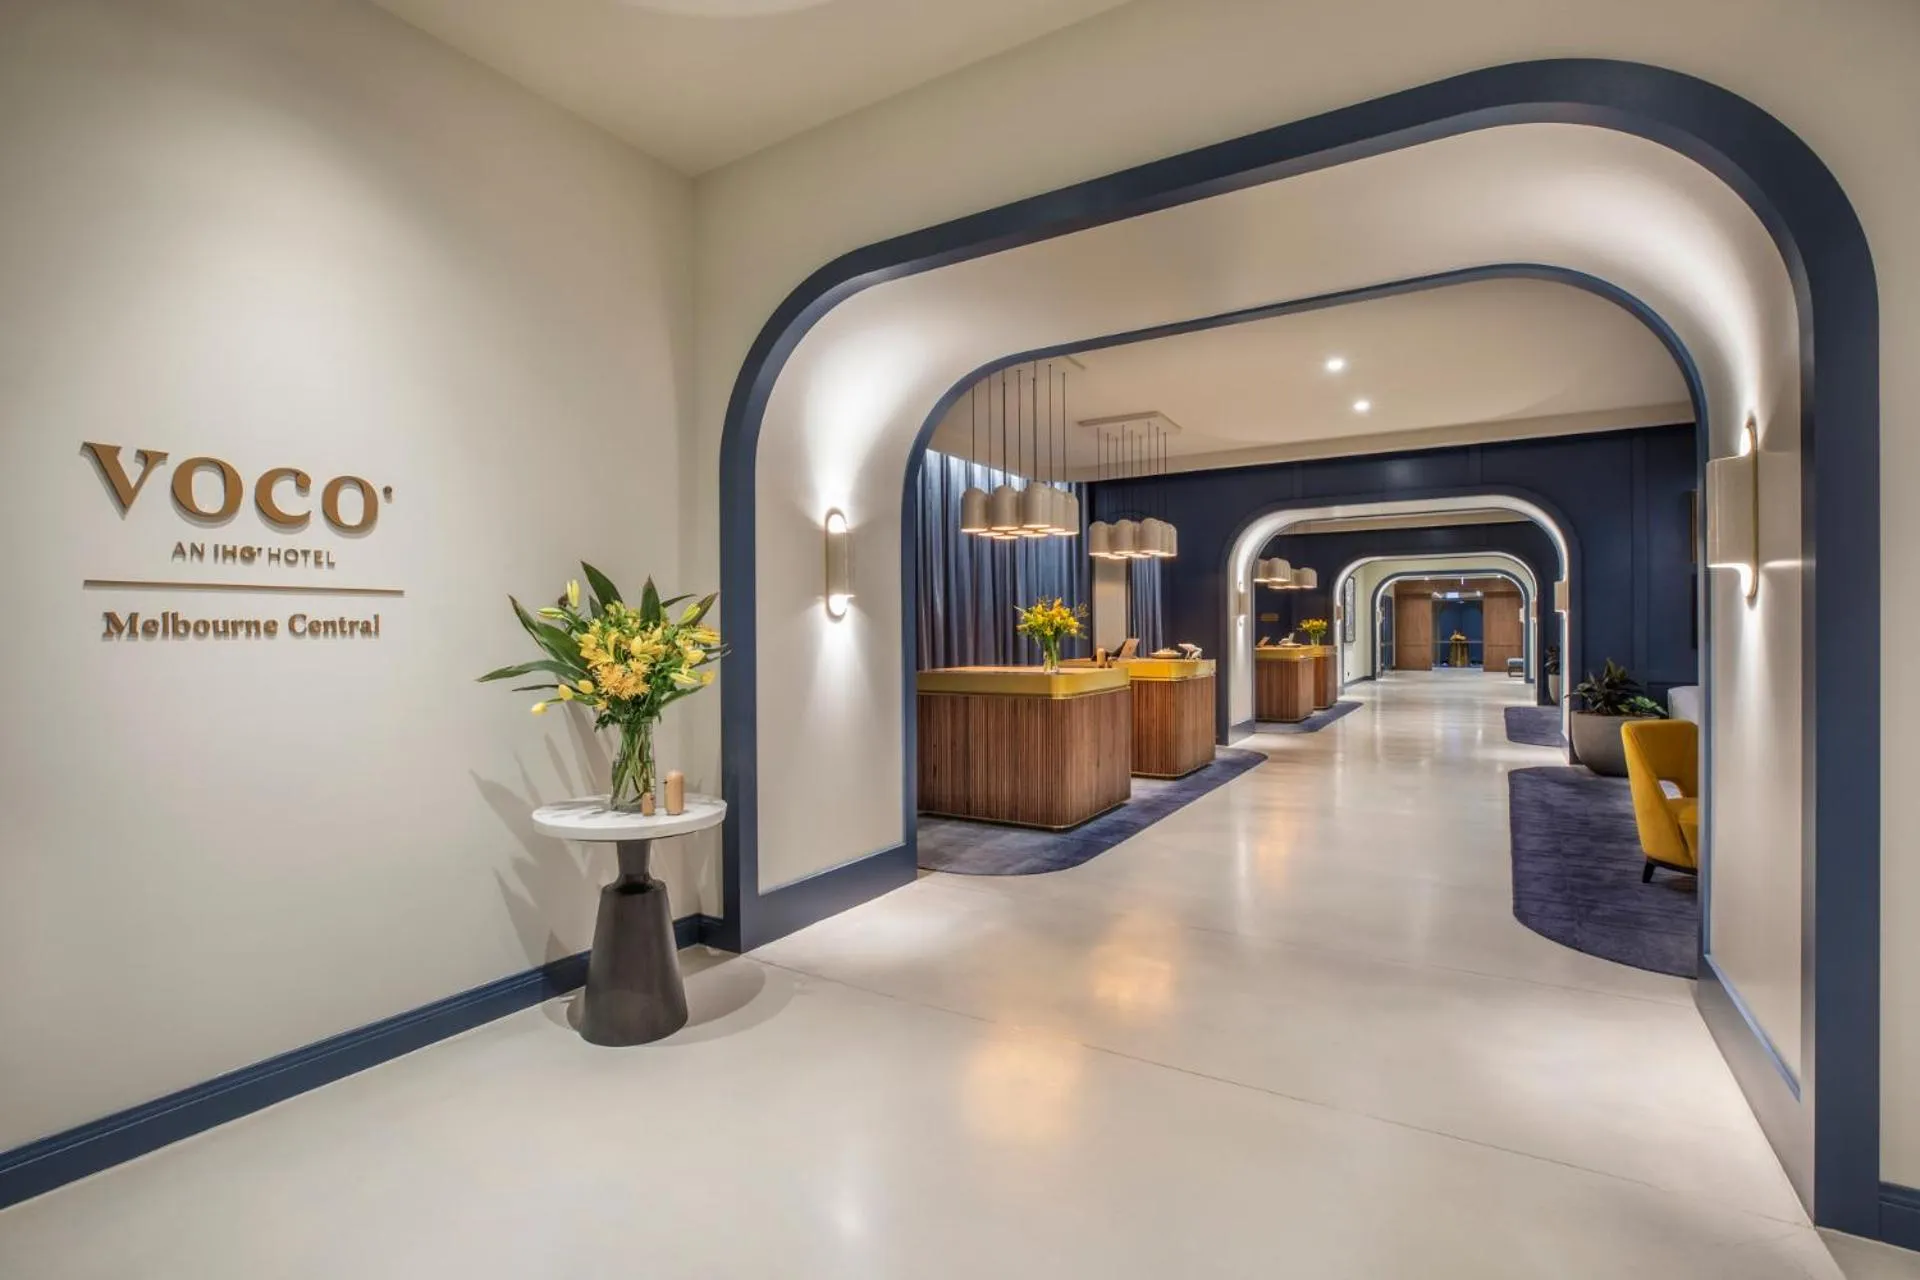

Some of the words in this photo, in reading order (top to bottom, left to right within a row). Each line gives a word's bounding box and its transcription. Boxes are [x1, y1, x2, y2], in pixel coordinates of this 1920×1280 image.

[172, 541, 205, 562] AN
[268, 547, 335, 568] HOTEL
[103, 611, 279, 638] Melbourne
[288, 613, 380, 639] Central
